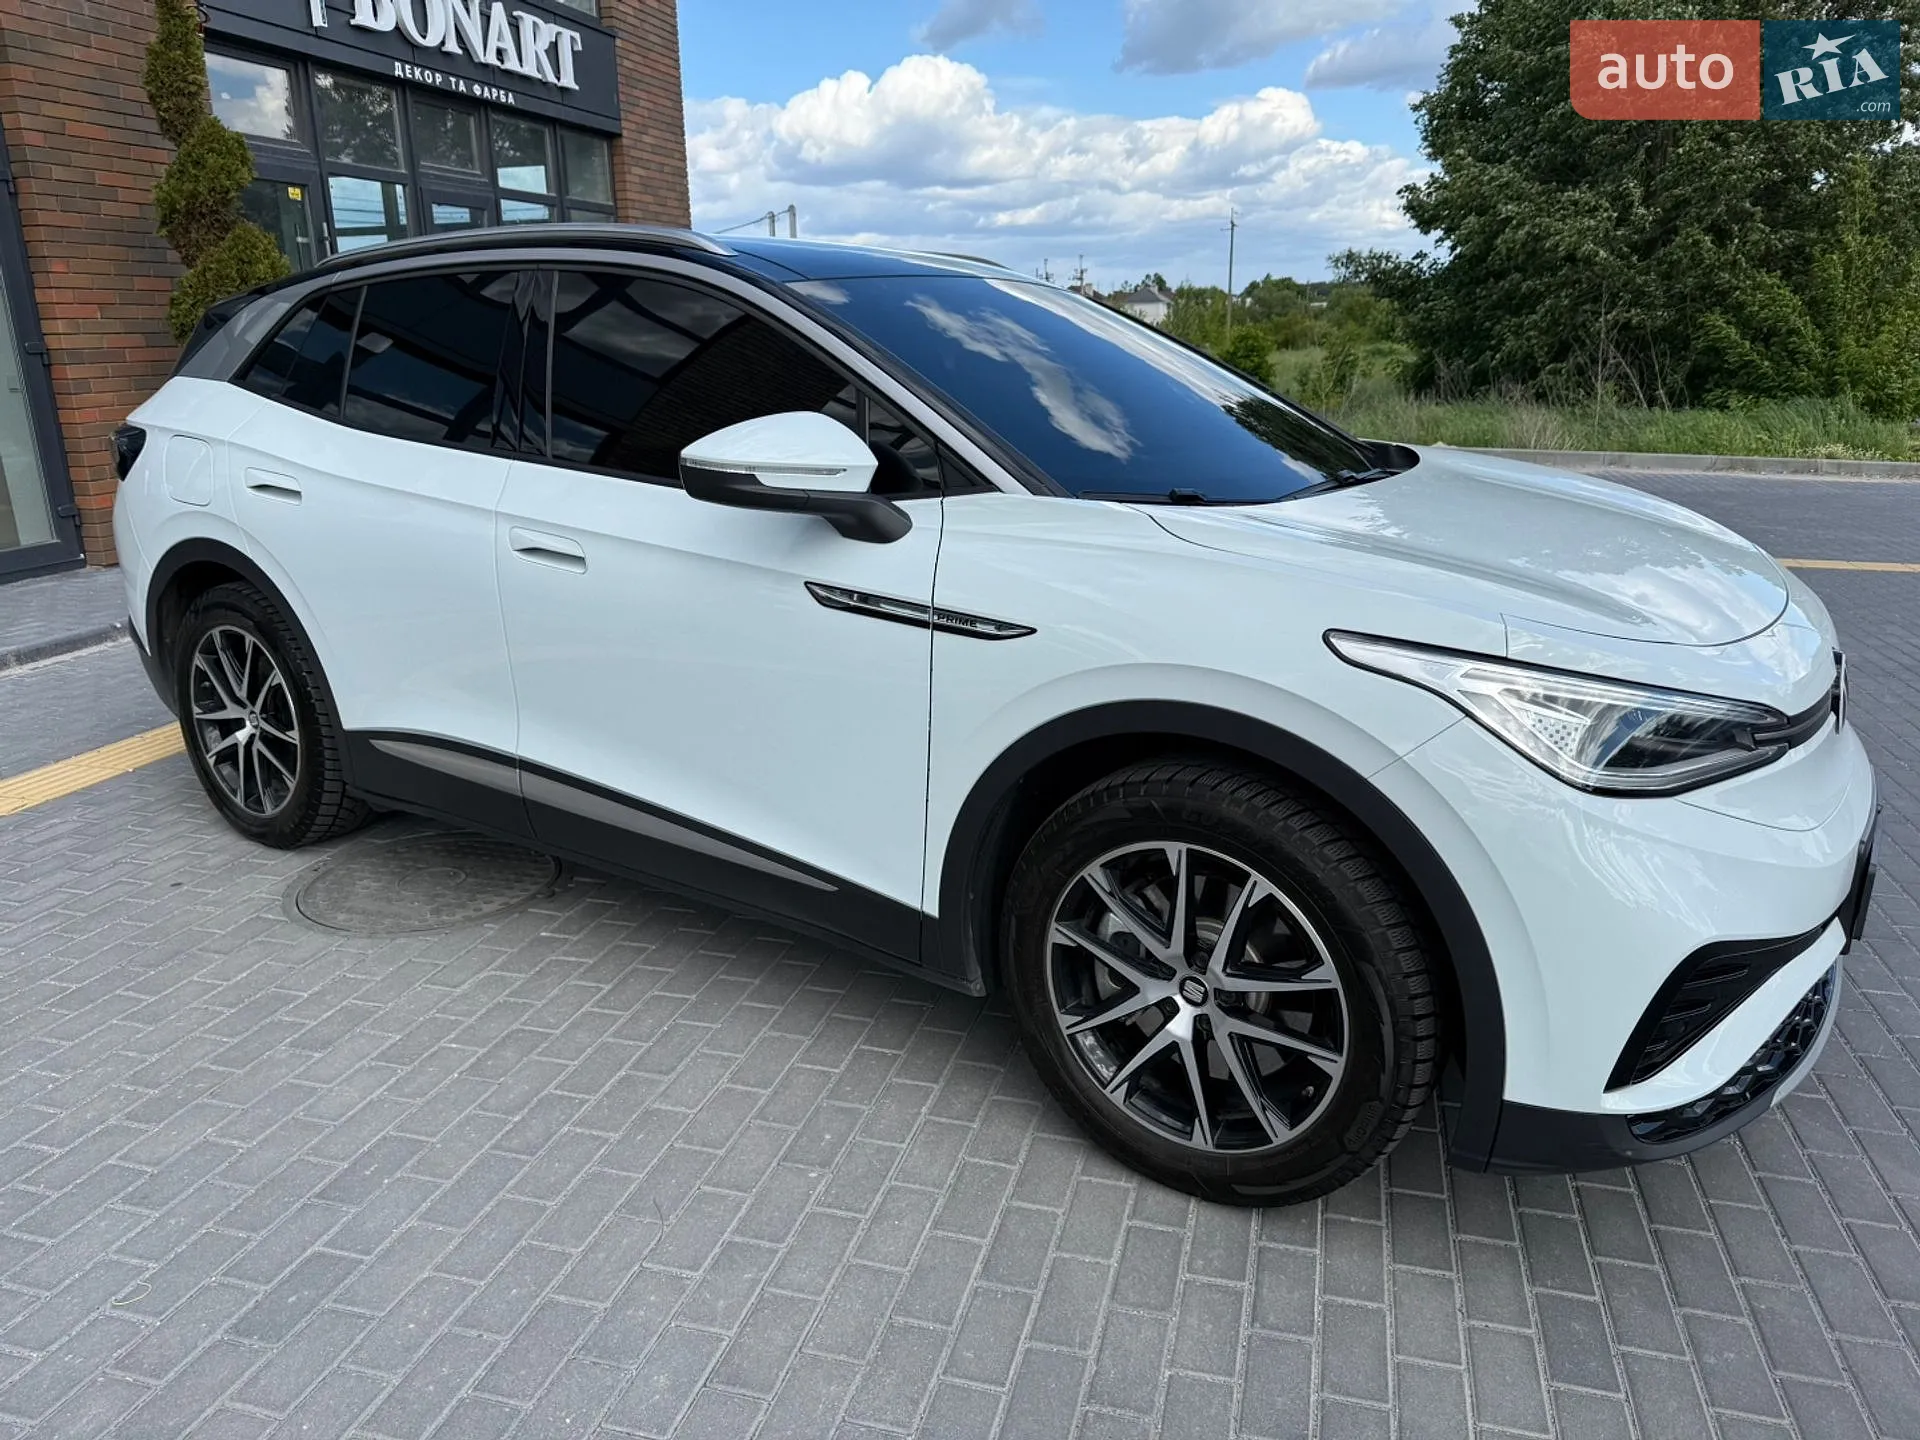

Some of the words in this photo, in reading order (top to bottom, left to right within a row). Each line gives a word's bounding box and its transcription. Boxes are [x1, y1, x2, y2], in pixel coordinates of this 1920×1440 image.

[394, 60, 444, 88] ДЕКОР
[449, 75, 467, 94] ТА
[472, 84, 516, 106] ФАРБА
[937, 614, 977, 628] PRIME
